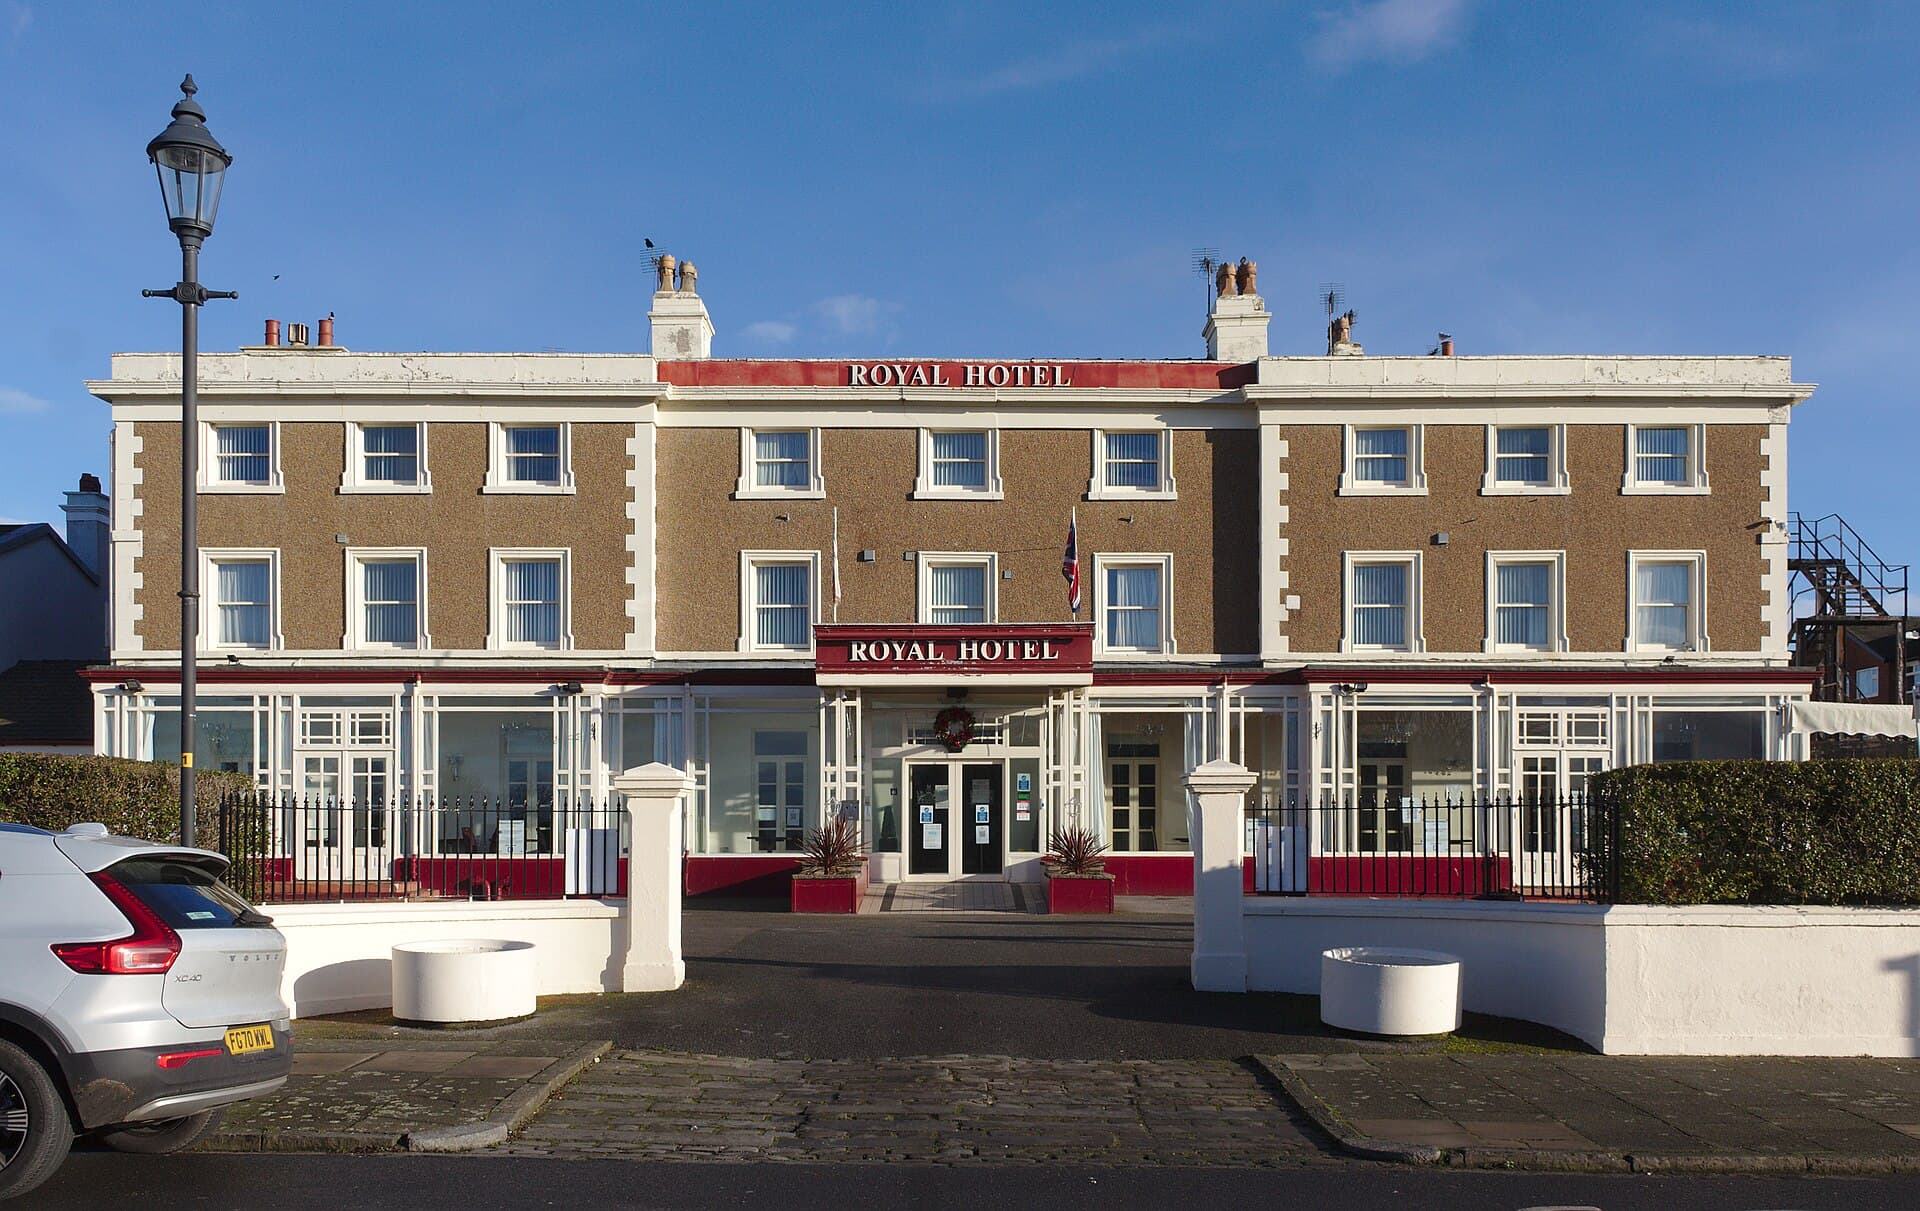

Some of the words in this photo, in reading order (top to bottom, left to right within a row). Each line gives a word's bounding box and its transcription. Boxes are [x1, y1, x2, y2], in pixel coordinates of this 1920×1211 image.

[850, 364, 949, 386] ROYAL
[965, 364, 1071, 386] HOTEL
[849, 640, 944, 661] ROYAL
[959, 639, 1059, 660] HOTEL
[230, 1030, 254, 1050] FG70
